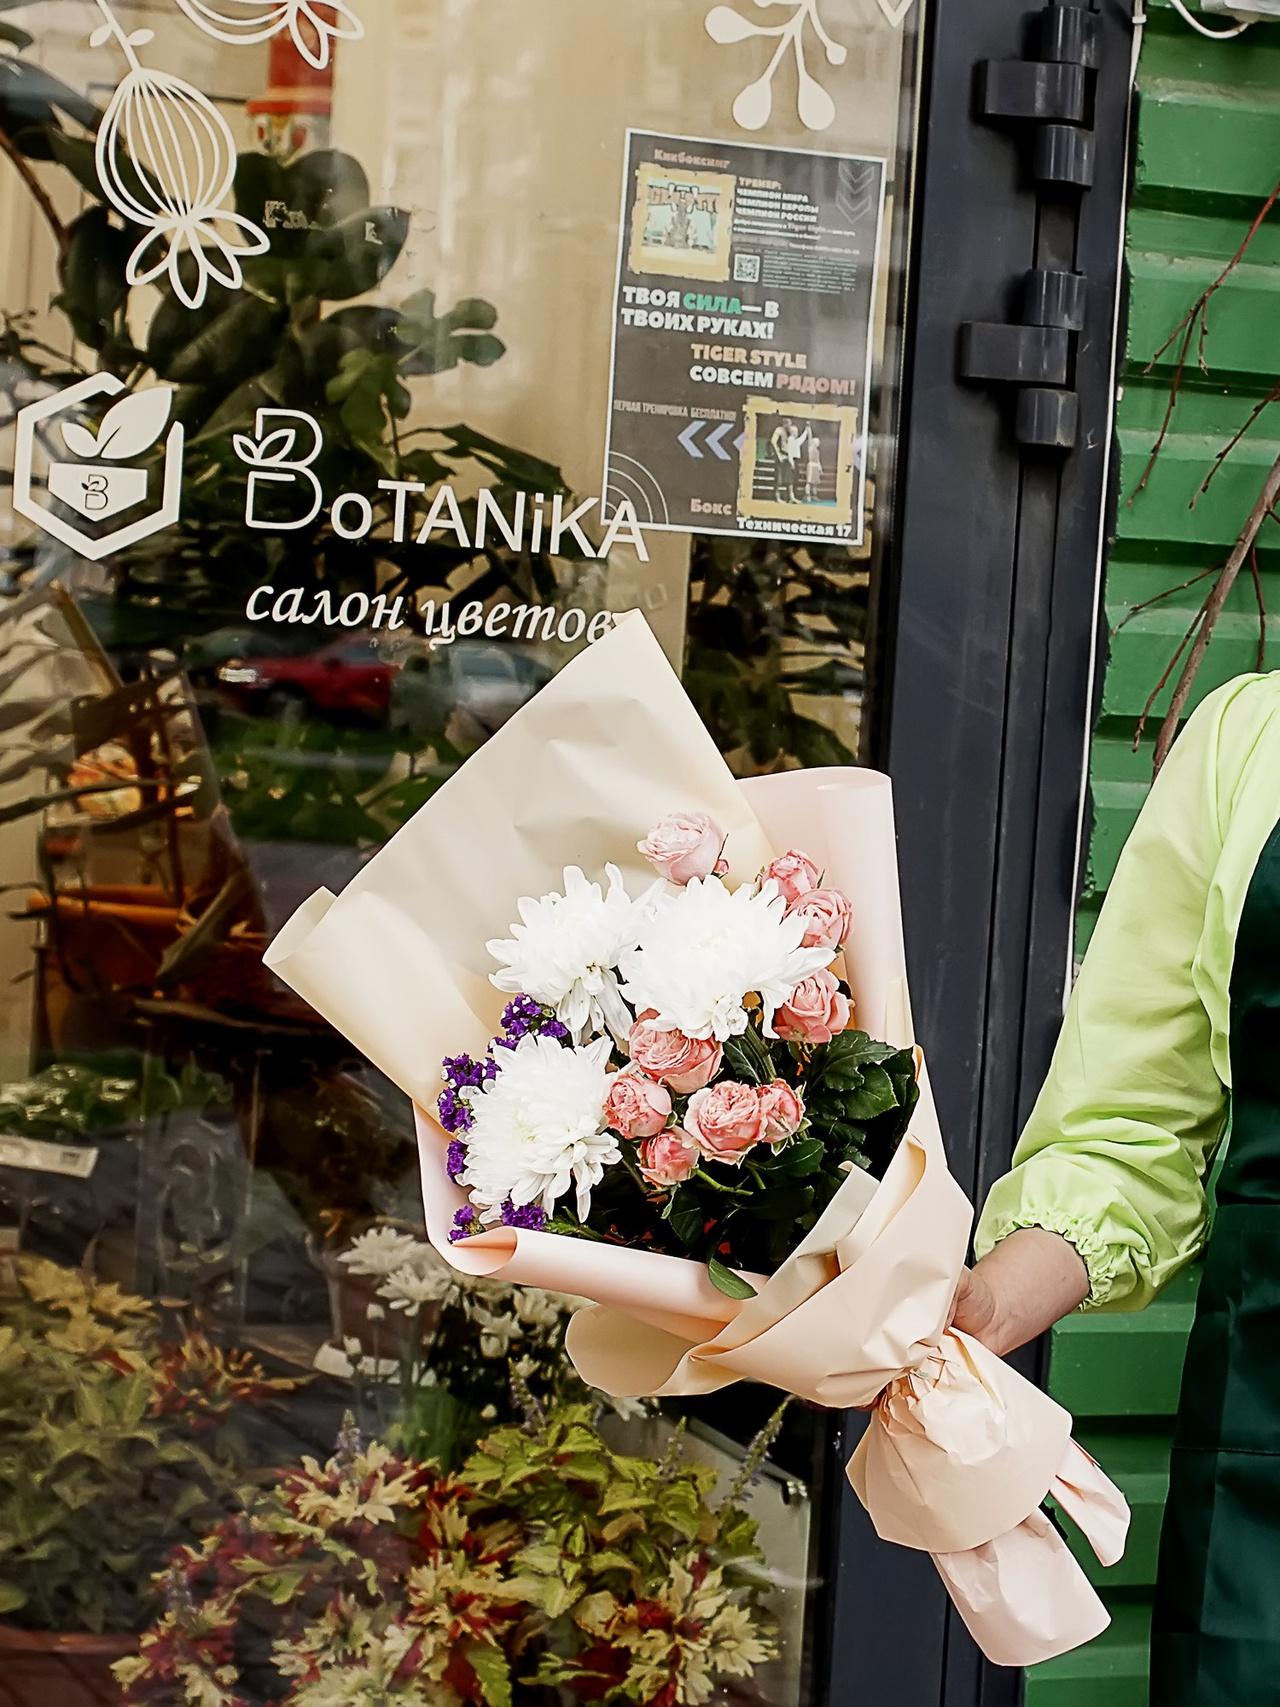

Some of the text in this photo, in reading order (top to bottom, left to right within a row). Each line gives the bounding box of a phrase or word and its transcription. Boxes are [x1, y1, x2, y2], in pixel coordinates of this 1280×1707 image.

[653, 149, 731, 169] Кикбоксинг
[622, 285, 681, 309] ТВОЯ
[764, 300, 780, 318] В
[620, 308, 775, 340] ТВОИХ РУКАХ!
[690, 343, 808, 370] TIGER STYLE
[689, 365, 857, 396] СОВСЕМ РЯДОМ!
[690, 497, 732, 516] Бокс
[736, 516, 853, 538] Техническая 17
[245, 585, 614, 651] салон цветов
